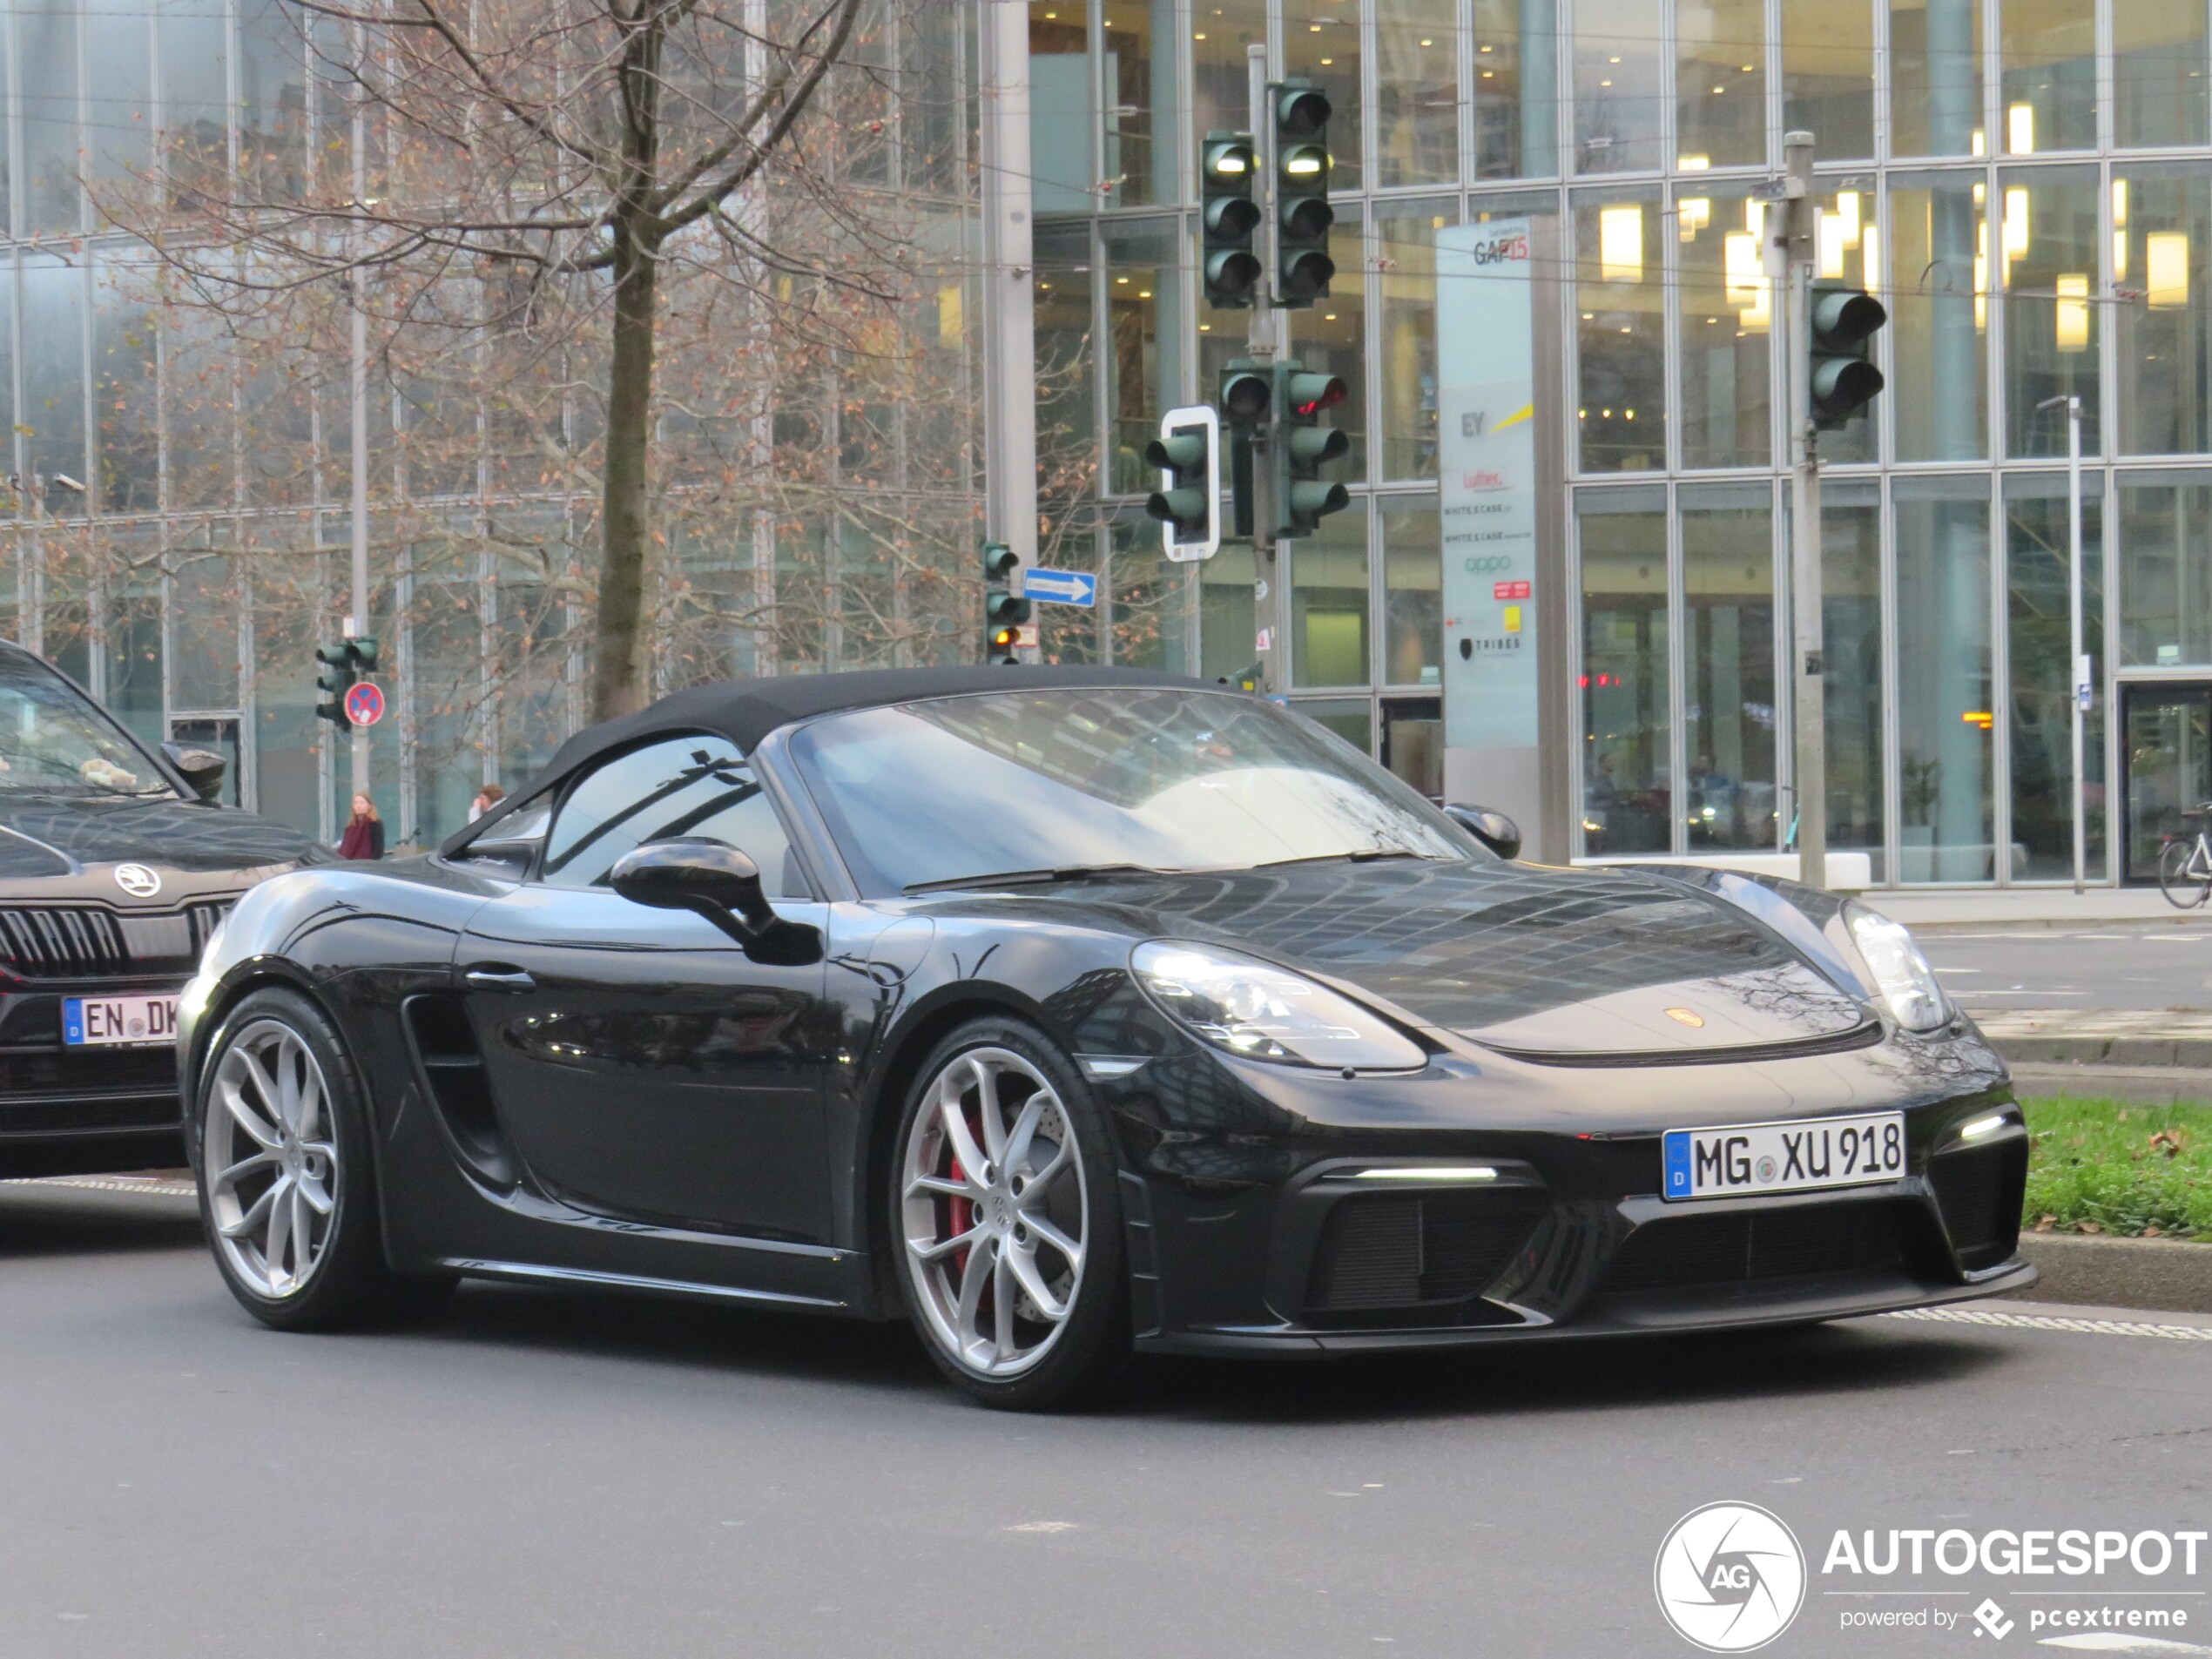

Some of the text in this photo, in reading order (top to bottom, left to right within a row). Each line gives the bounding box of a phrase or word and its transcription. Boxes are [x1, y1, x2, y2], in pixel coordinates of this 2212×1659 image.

[1461, 411, 1485, 437] EY
[1480, 504, 1502, 514] CASE
[1480, 531, 1504, 541] CASE
[1475, 638, 1521, 651] TRIBES
[87, 1003, 124, 1037] EN
[1696, 1123, 1901, 1187] MG XU 918
[1674, 1172, 1684, 1185] D
